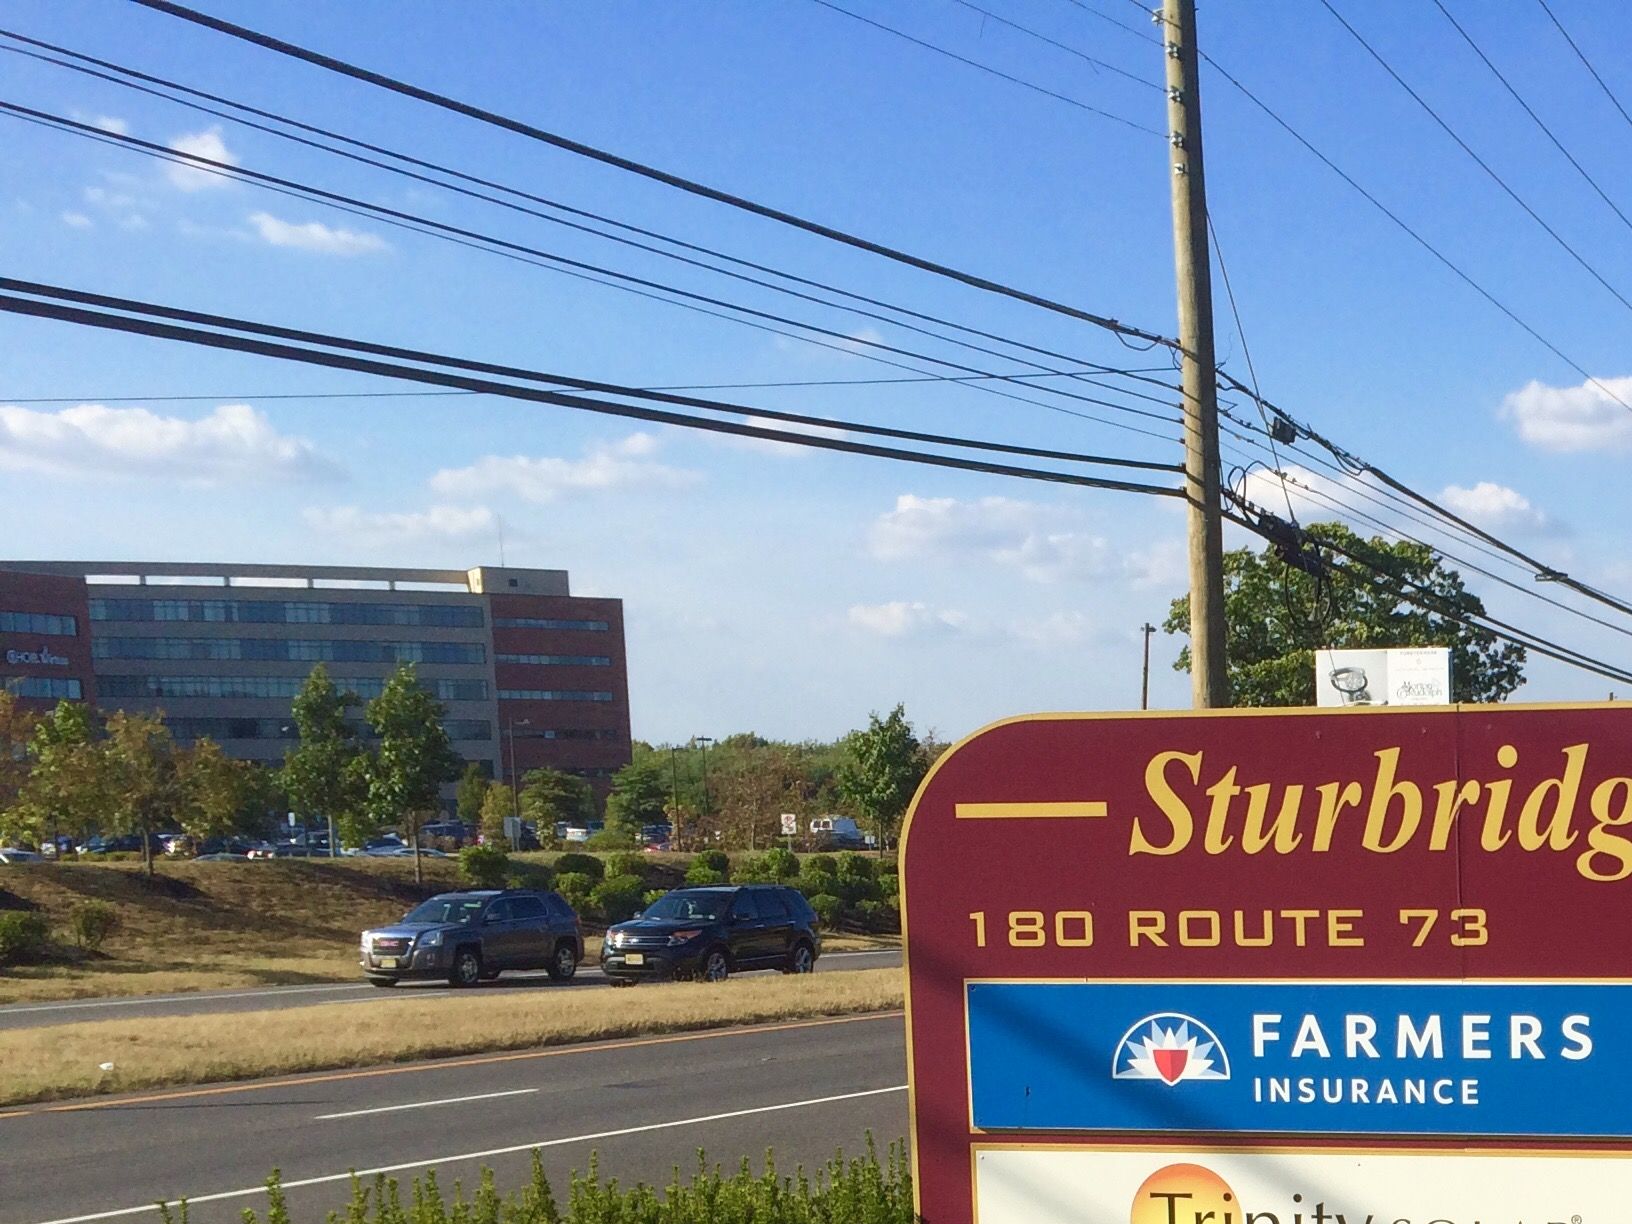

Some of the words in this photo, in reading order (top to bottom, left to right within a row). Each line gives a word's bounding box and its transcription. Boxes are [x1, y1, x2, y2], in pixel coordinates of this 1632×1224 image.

[969, 910, 1094, 947] 180
[1128, 909, 1365, 947] ROUTE
[1399, 908, 1488, 947] 73
[1253, 1014, 1593, 1060] FARMERS
[1254, 1077, 1479, 1105] INSURANCE
